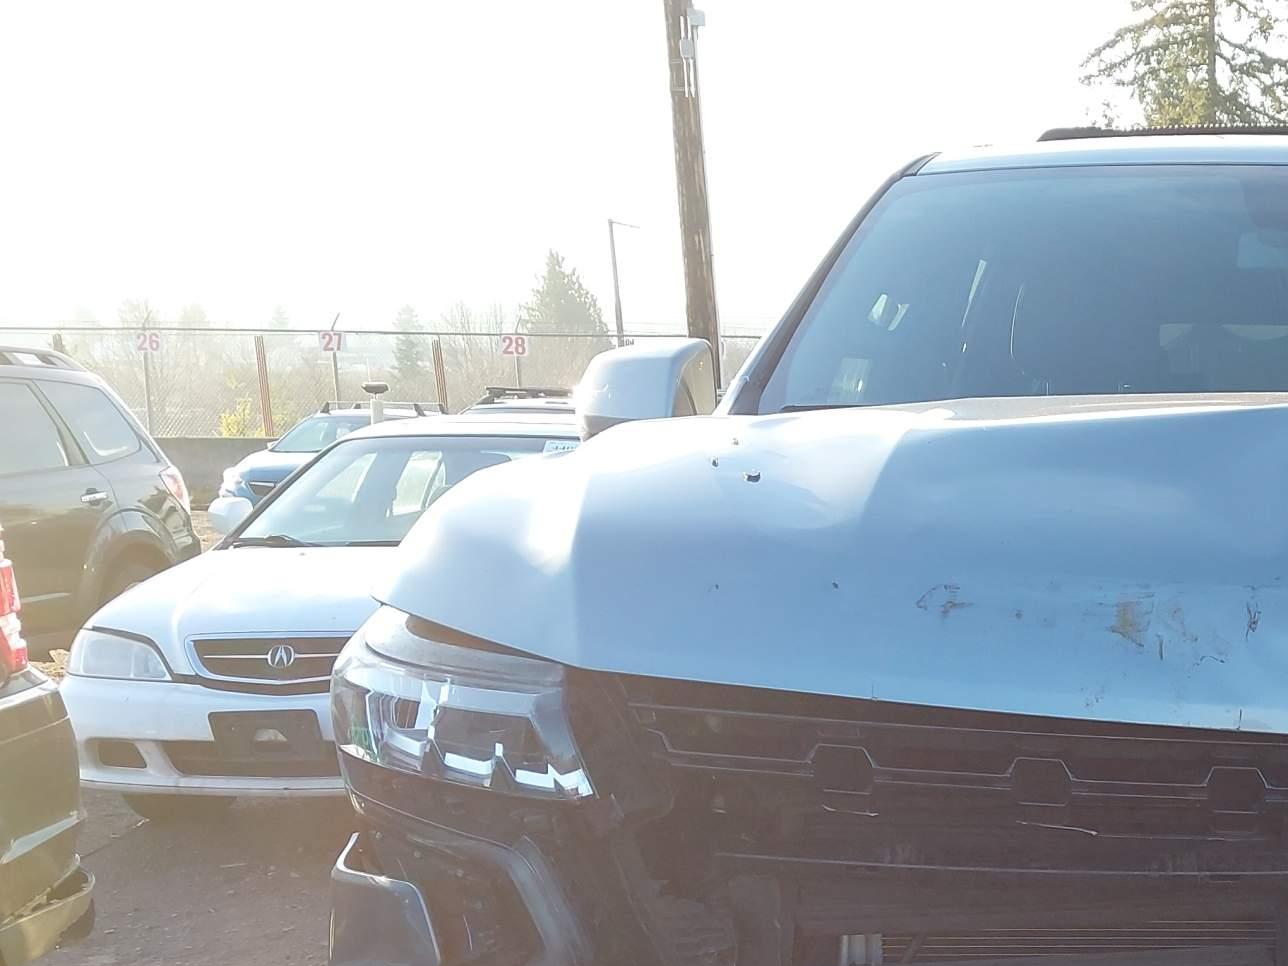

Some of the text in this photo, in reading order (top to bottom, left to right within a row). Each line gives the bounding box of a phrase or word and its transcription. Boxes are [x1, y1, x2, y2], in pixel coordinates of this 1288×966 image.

[137, 332, 160, 351] 26
[321, 332, 342, 351] 27
[502, 336, 526, 355] 28
